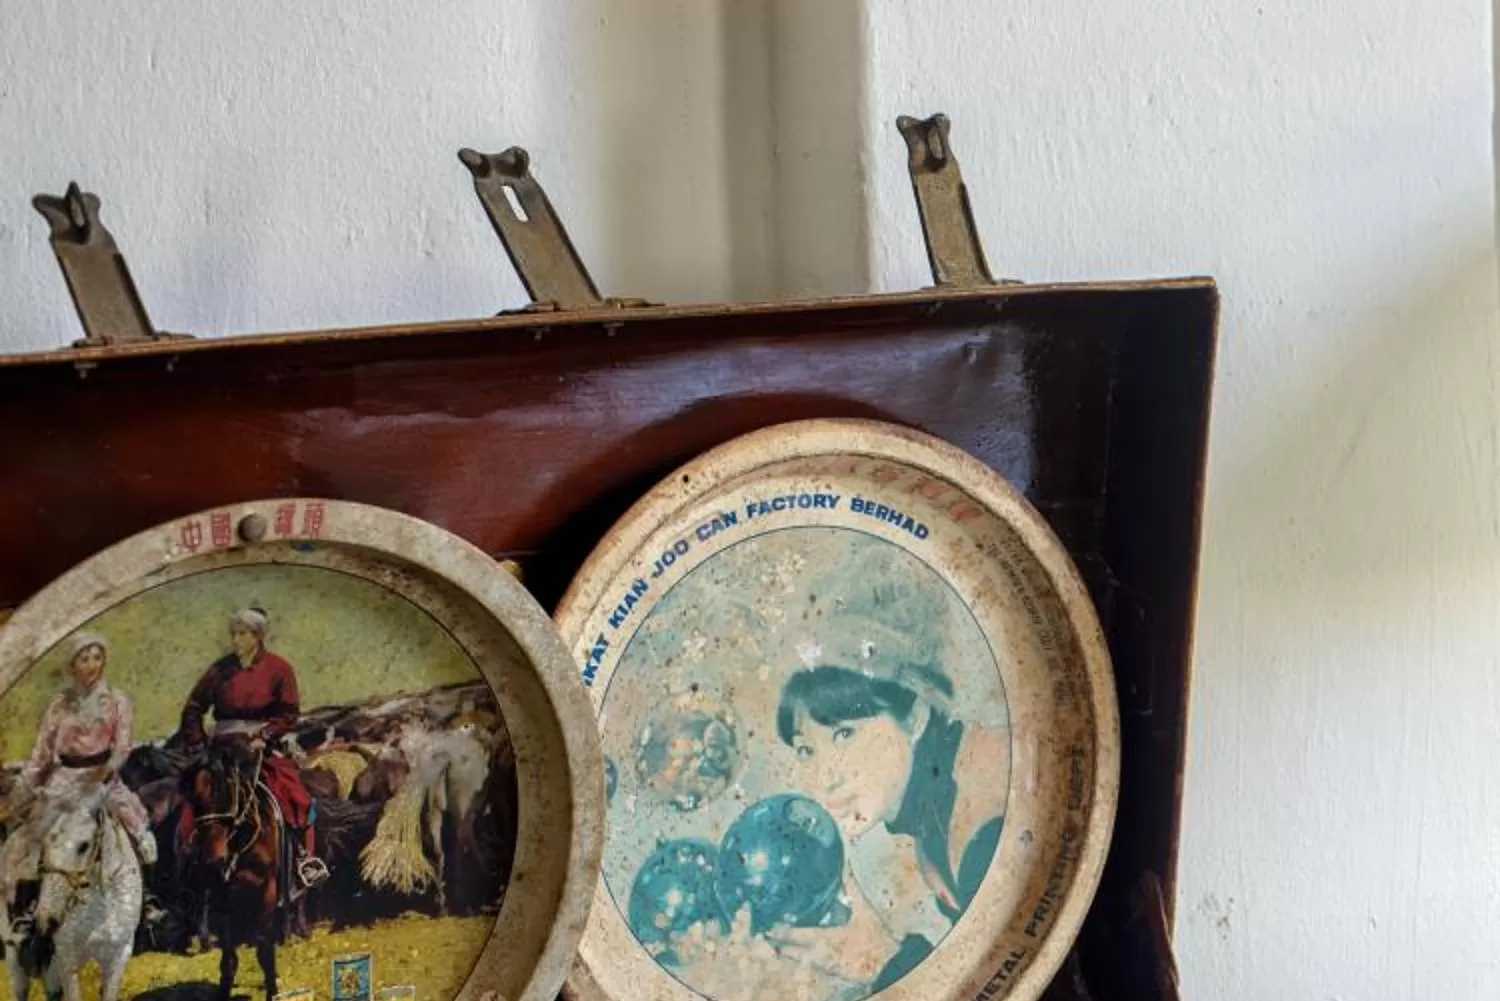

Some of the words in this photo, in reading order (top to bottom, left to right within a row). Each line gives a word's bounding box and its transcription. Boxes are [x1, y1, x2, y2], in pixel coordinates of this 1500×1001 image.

[607, 577, 650, 629] KIAN
[651, 539, 690, 579] JOO
[695, 511, 739, 542] CAN
[745, 494, 841, 519] FACTORY
[850, 496, 930, 540] BERHAD
[1023, 827, 1082, 938] PRINTING
